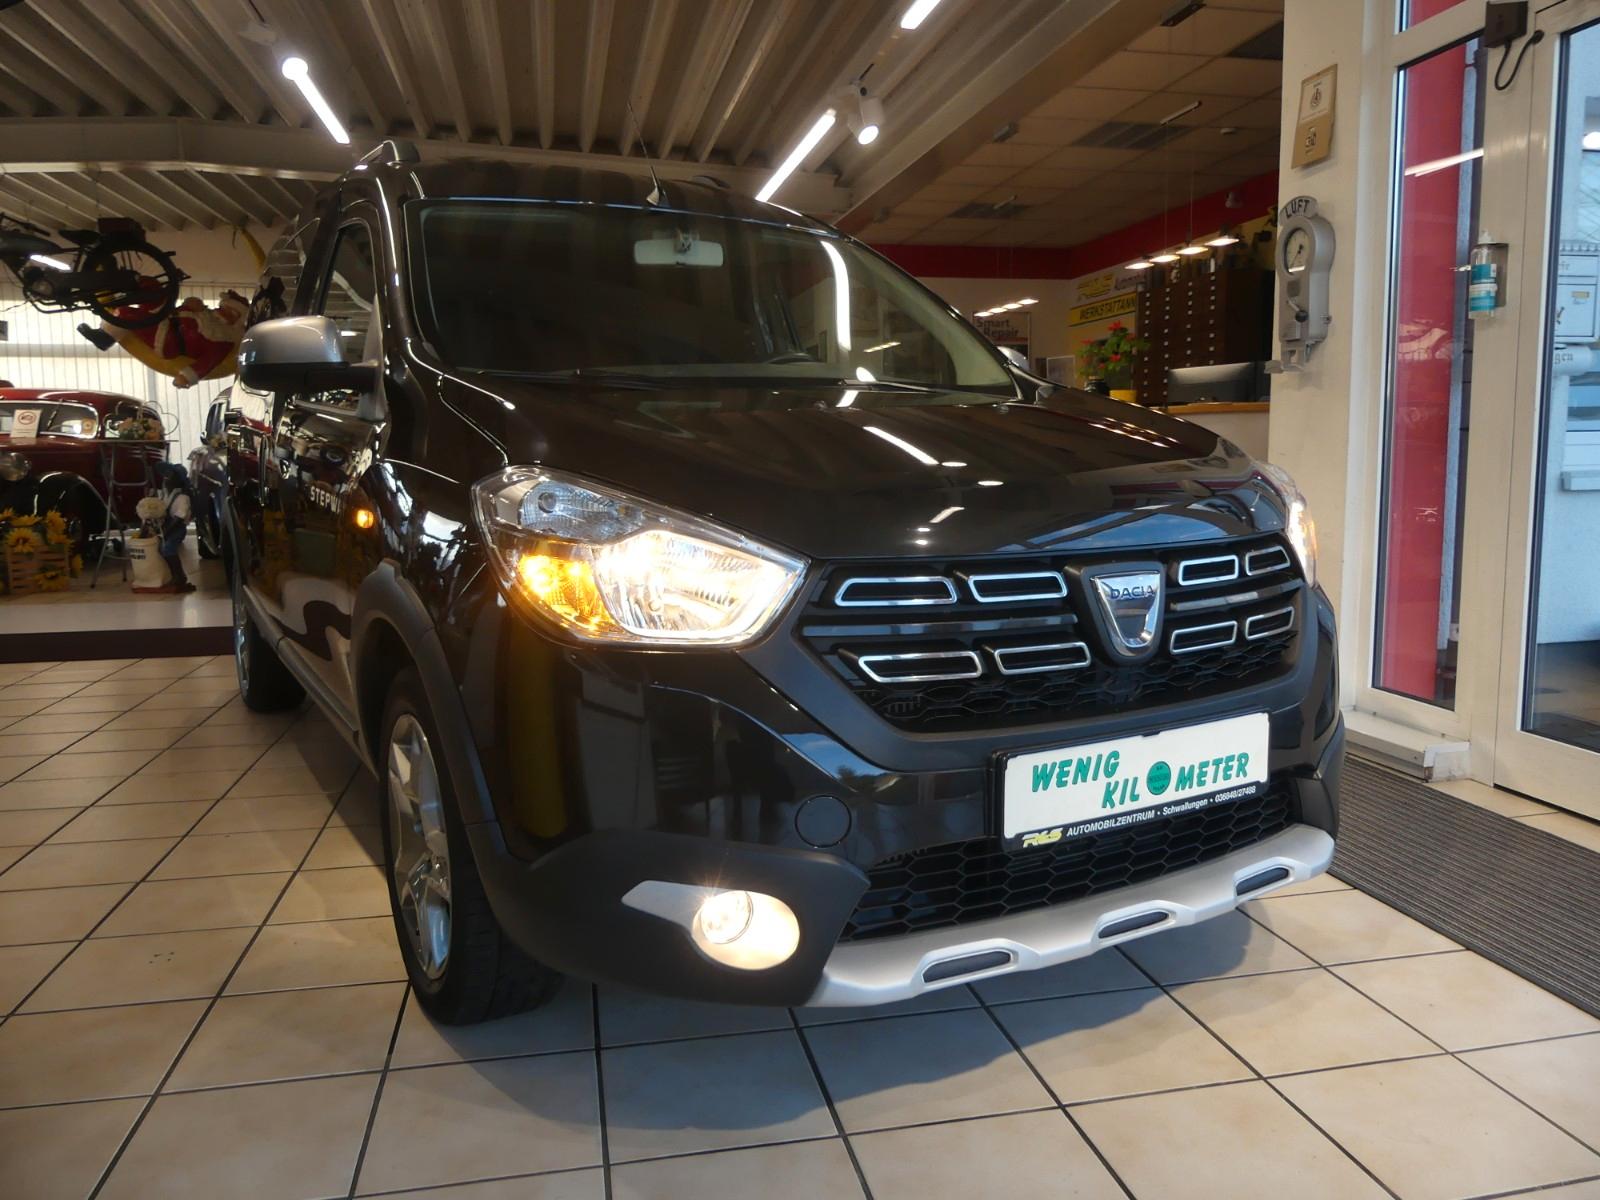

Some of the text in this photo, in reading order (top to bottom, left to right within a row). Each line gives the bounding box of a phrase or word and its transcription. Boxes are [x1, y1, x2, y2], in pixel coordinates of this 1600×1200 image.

[1285, 199, 1310, 219] LUFT
[976, 319, 1009, 330] Smart
[983, 327, 1020, 340] Repair
[1110, 585, 1155, 599] DACIA
[1032, 750, 1121, 793] WENIG
[1066, 810, 1155, 837] AUTOMOBILZENTRUM
[1162, 797, 1208, 816] Schwallungen
